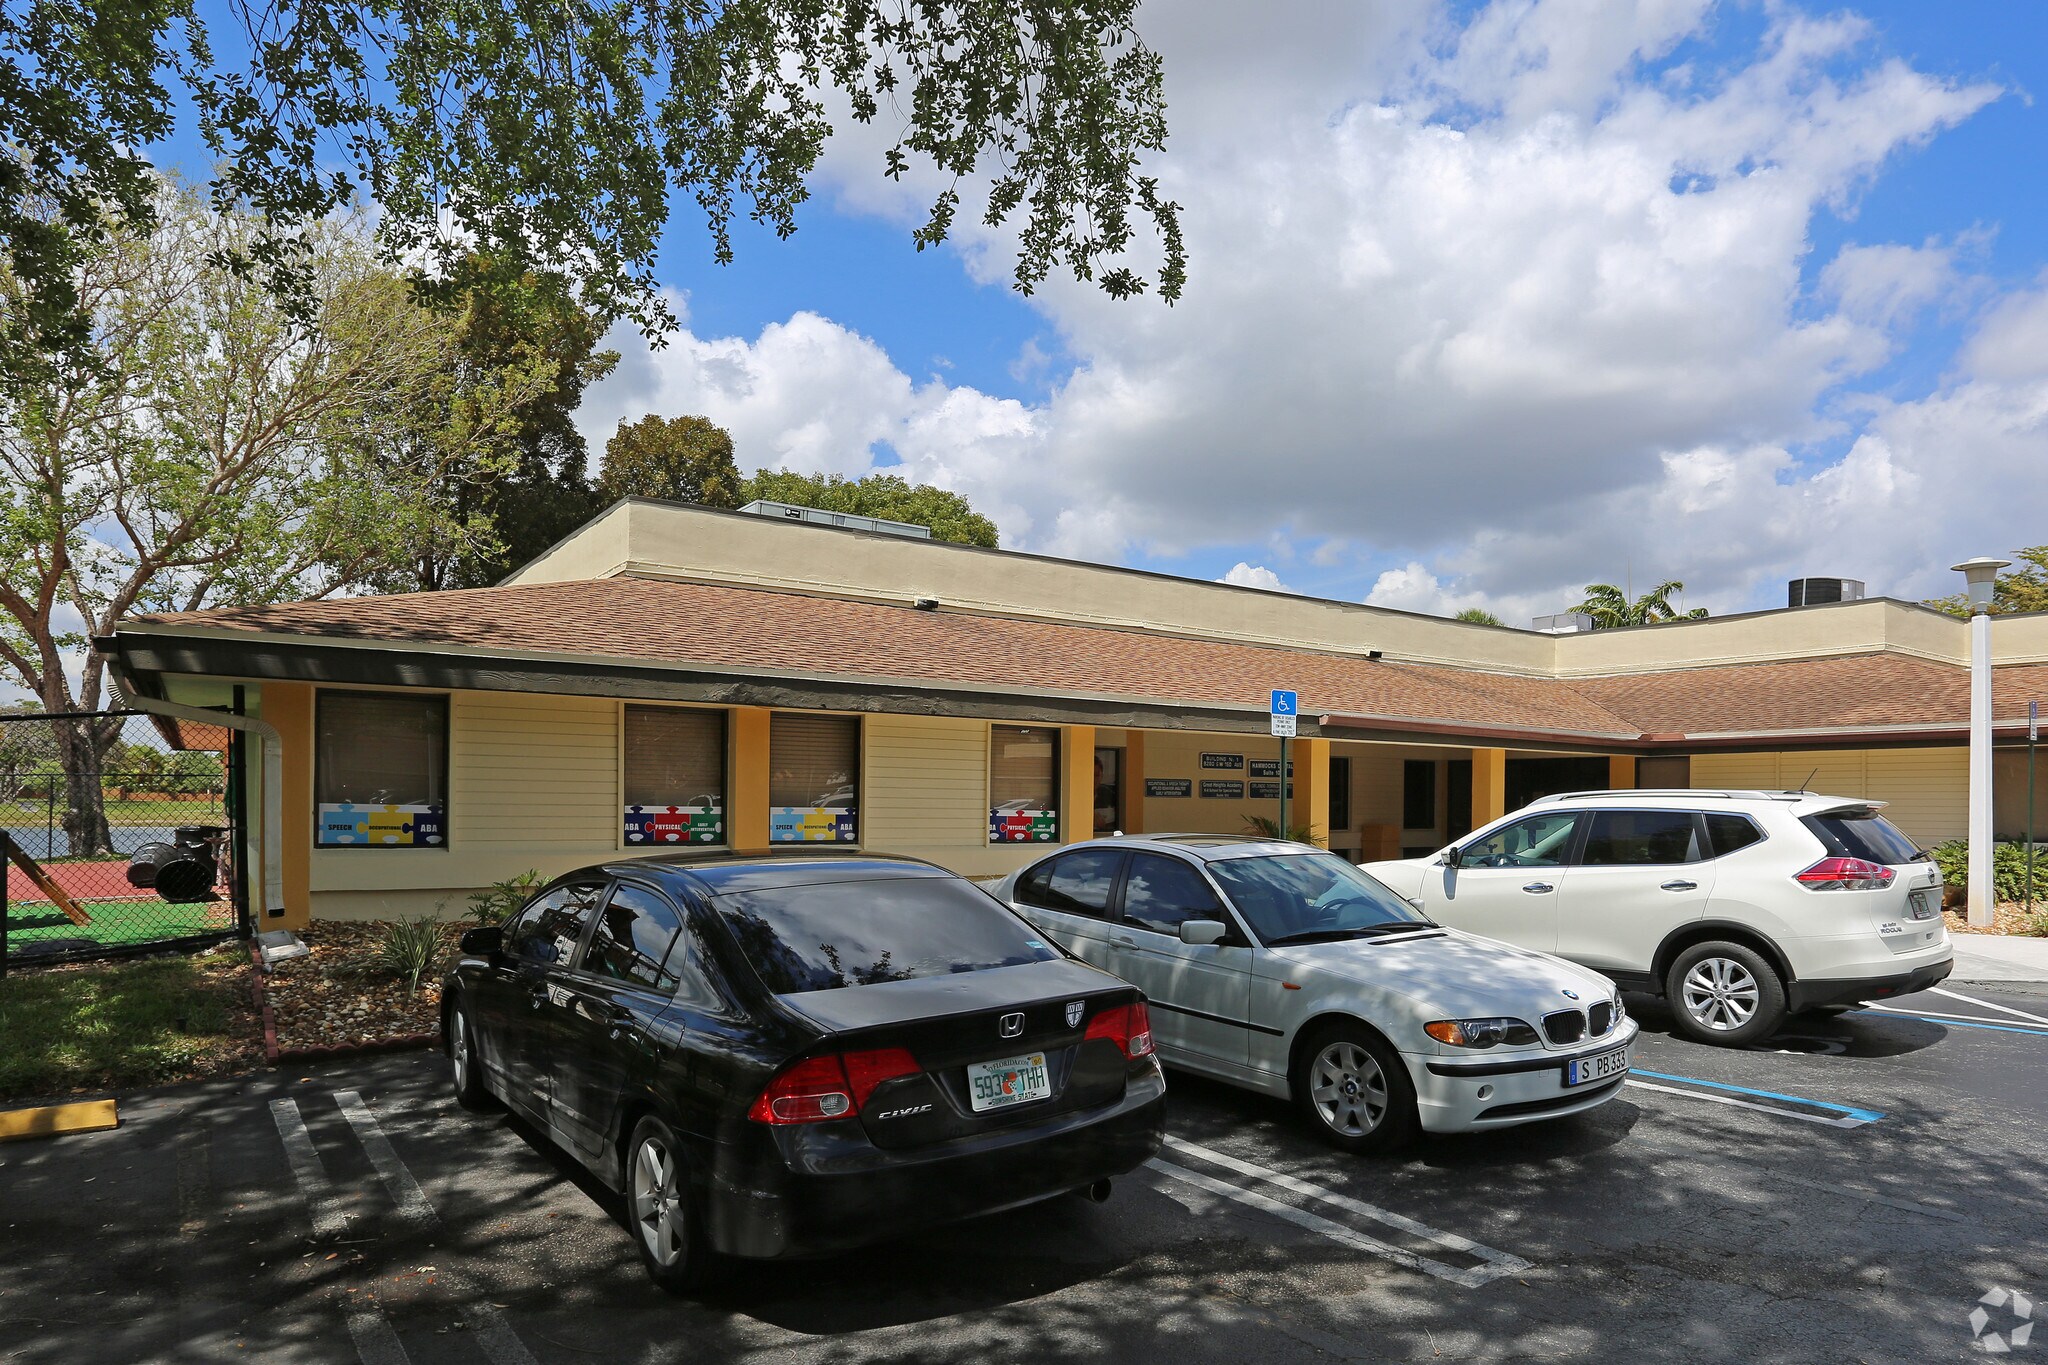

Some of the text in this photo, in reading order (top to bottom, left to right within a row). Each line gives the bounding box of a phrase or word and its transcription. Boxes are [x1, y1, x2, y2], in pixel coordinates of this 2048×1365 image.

[420, 824, 438, 832] ABA
[624, 823, 639, 831] ABA
[840, 823, 853, 831] ABA
[1581, 1061, 1590, 1079] S
[1018, 1091, 1034, 1101] STATE
[878, 1104, 932, 1119] CIVIC
